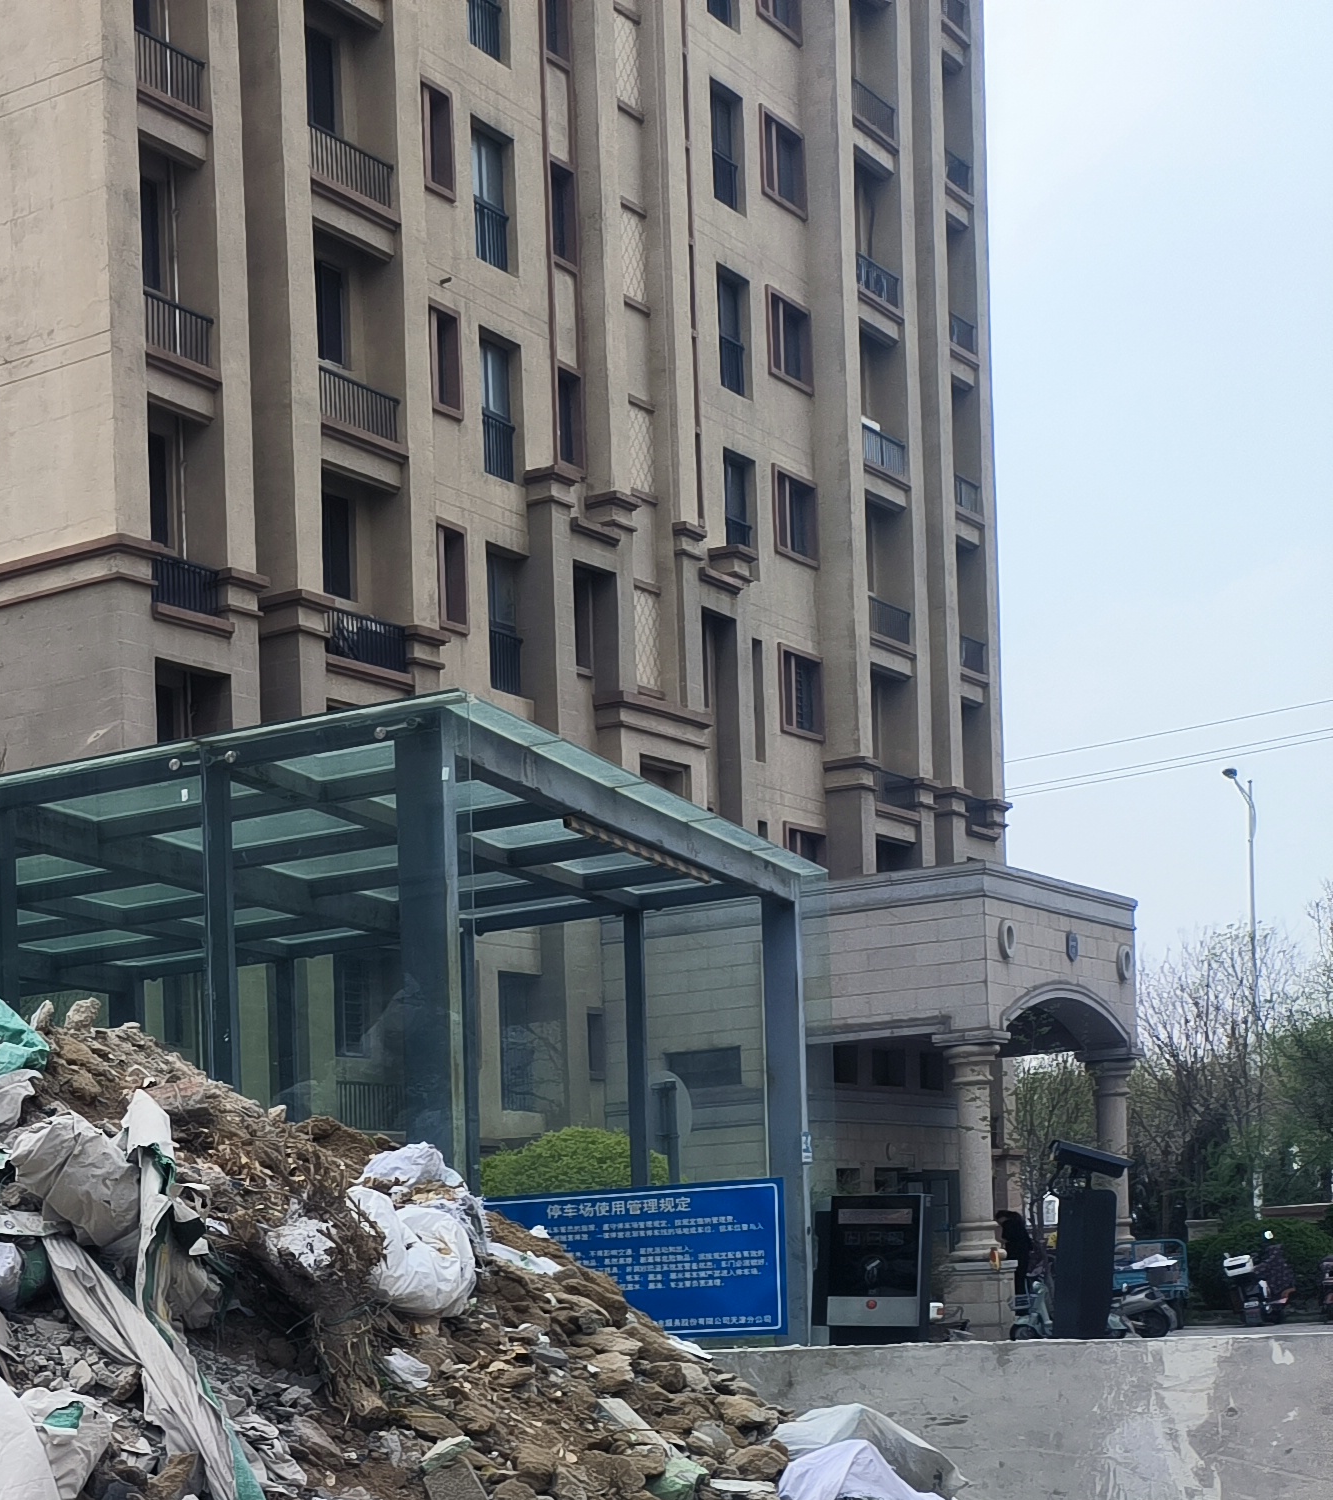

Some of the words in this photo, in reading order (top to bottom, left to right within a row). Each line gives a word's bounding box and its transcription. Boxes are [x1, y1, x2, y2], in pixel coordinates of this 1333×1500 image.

[547, 1197, 691, 1219] 停车场使用管理规定
